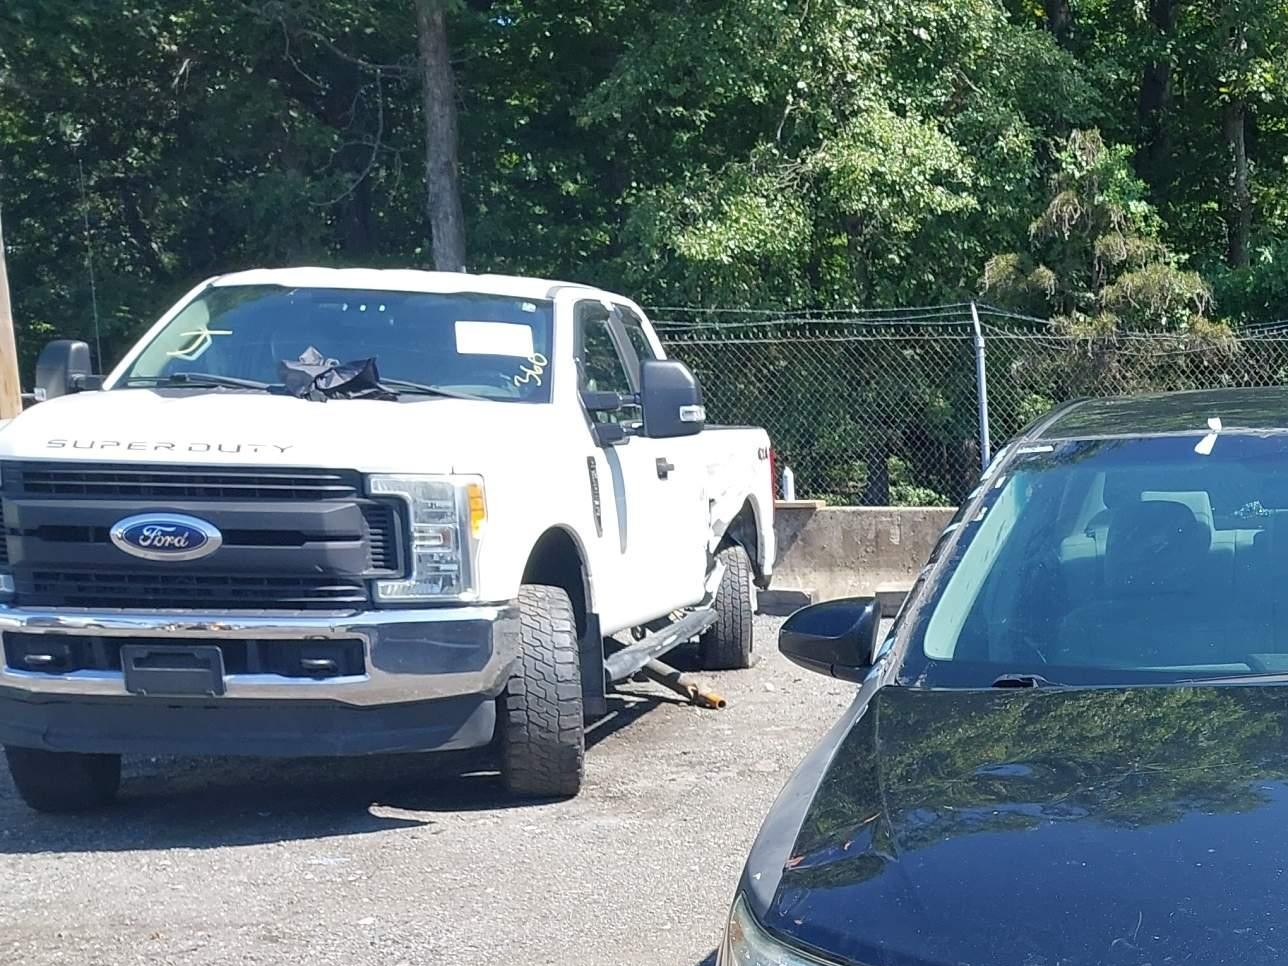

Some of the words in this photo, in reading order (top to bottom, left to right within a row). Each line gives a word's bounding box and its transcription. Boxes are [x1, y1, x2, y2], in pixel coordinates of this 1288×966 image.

[46, 438, 177, 452] SUPER
[187, 442, 295, 454] DUTY
[138, 524, 190, 549] Ford
